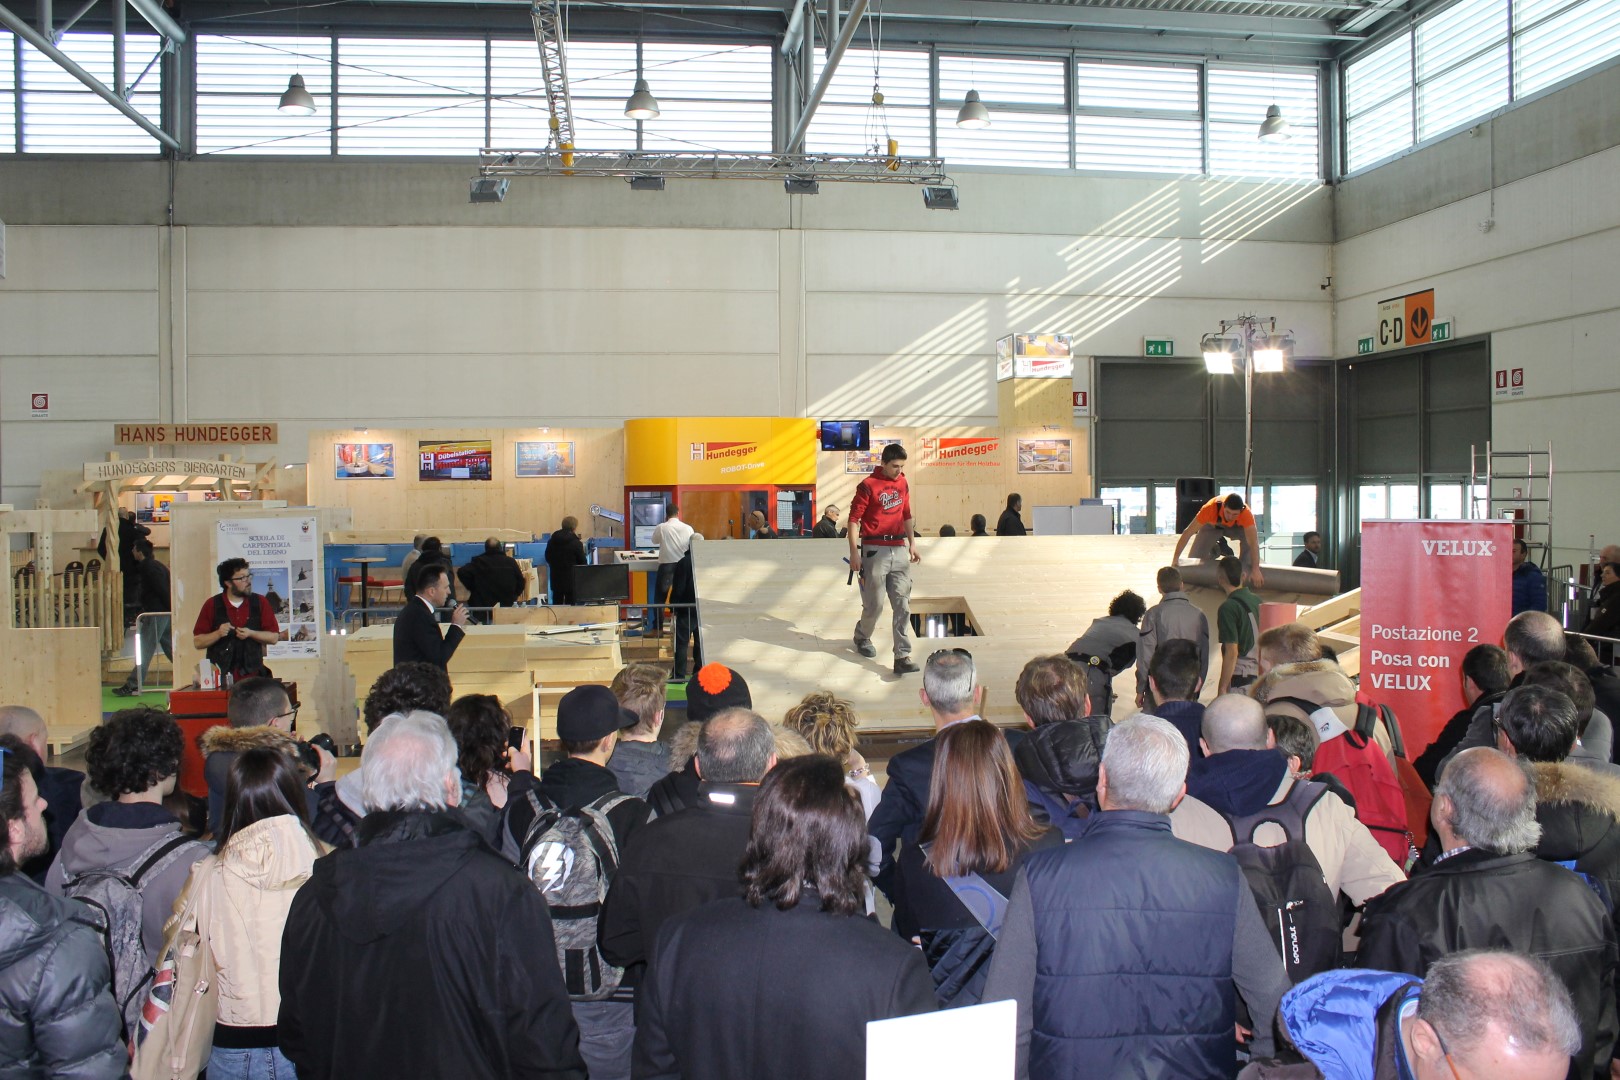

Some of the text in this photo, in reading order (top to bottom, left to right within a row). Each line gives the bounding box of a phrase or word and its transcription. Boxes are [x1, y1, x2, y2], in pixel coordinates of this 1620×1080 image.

[1380, 317, 1403, 346] C-D
[1031, 363, 1065, 373] Hundegger
[120, 426, 272, 442] HANS HUNDEGGER
[438, 448, 477, 460] Dübelstation
[706, 446, 758, 460] Hundegger
[939, 443, 999, 460] Hundegger
[98, 461, 246, 478] HUNDEGGERS BIERGARTEN
[720, 462, 765, 474] ROBOT-Drive
[1421, 540, 1493, 556] VELUX
[1371, 624, 1479, 643] Postazione 2
[1371, 650, 1450, 667] Posa con
[1370, 673, 1432, 691] VELUX
[1289, 926, 1300, 964] Geonaut
